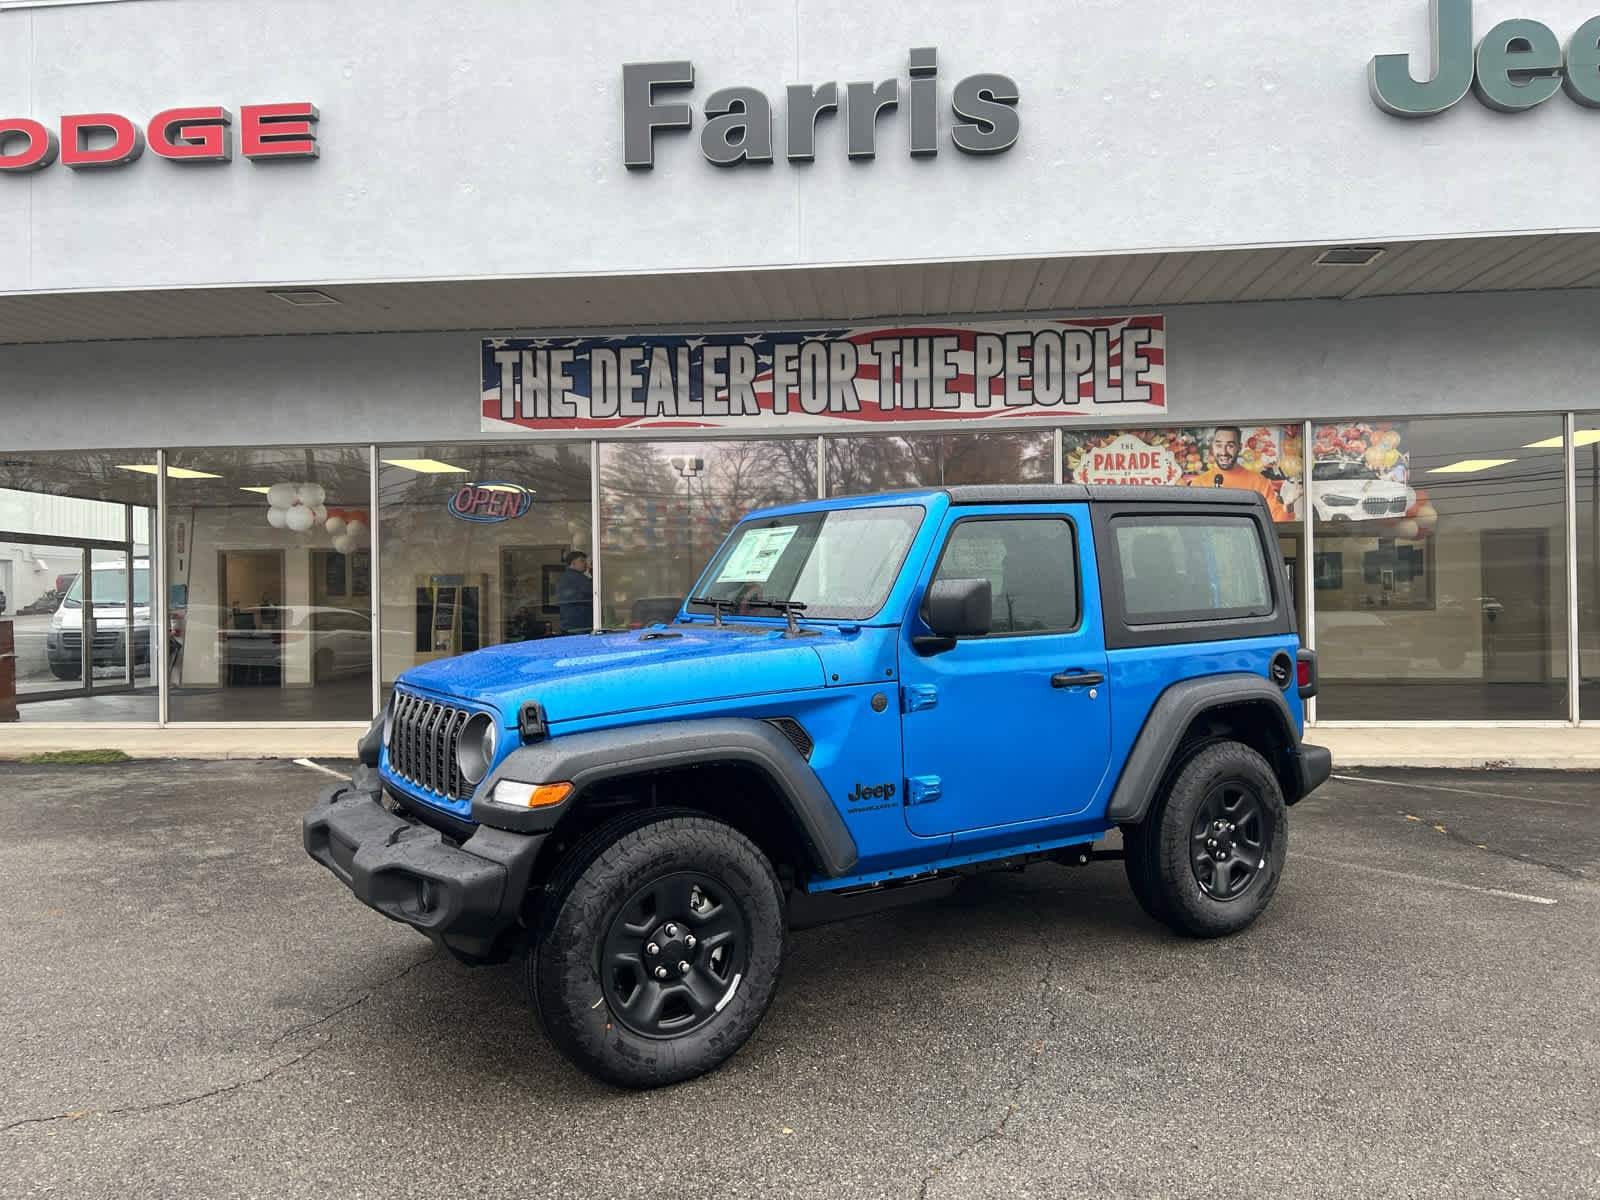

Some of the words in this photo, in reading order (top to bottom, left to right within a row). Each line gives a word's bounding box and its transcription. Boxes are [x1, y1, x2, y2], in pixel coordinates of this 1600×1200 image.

[622, 47, 1020, 169] Farris
[494, 349, 577, 419] THE
[590, 344, 761, 418] DEALER
[772, 339, 861, 415] FOR
[871, 335, 960, 411] THE
[974, 327, 1152, 408] PEOPLE
[1094, 452, 1161, 471] PARADE
[455, 486, 521, 518] OPEN
[847, 782, 896, 802] Jeep
